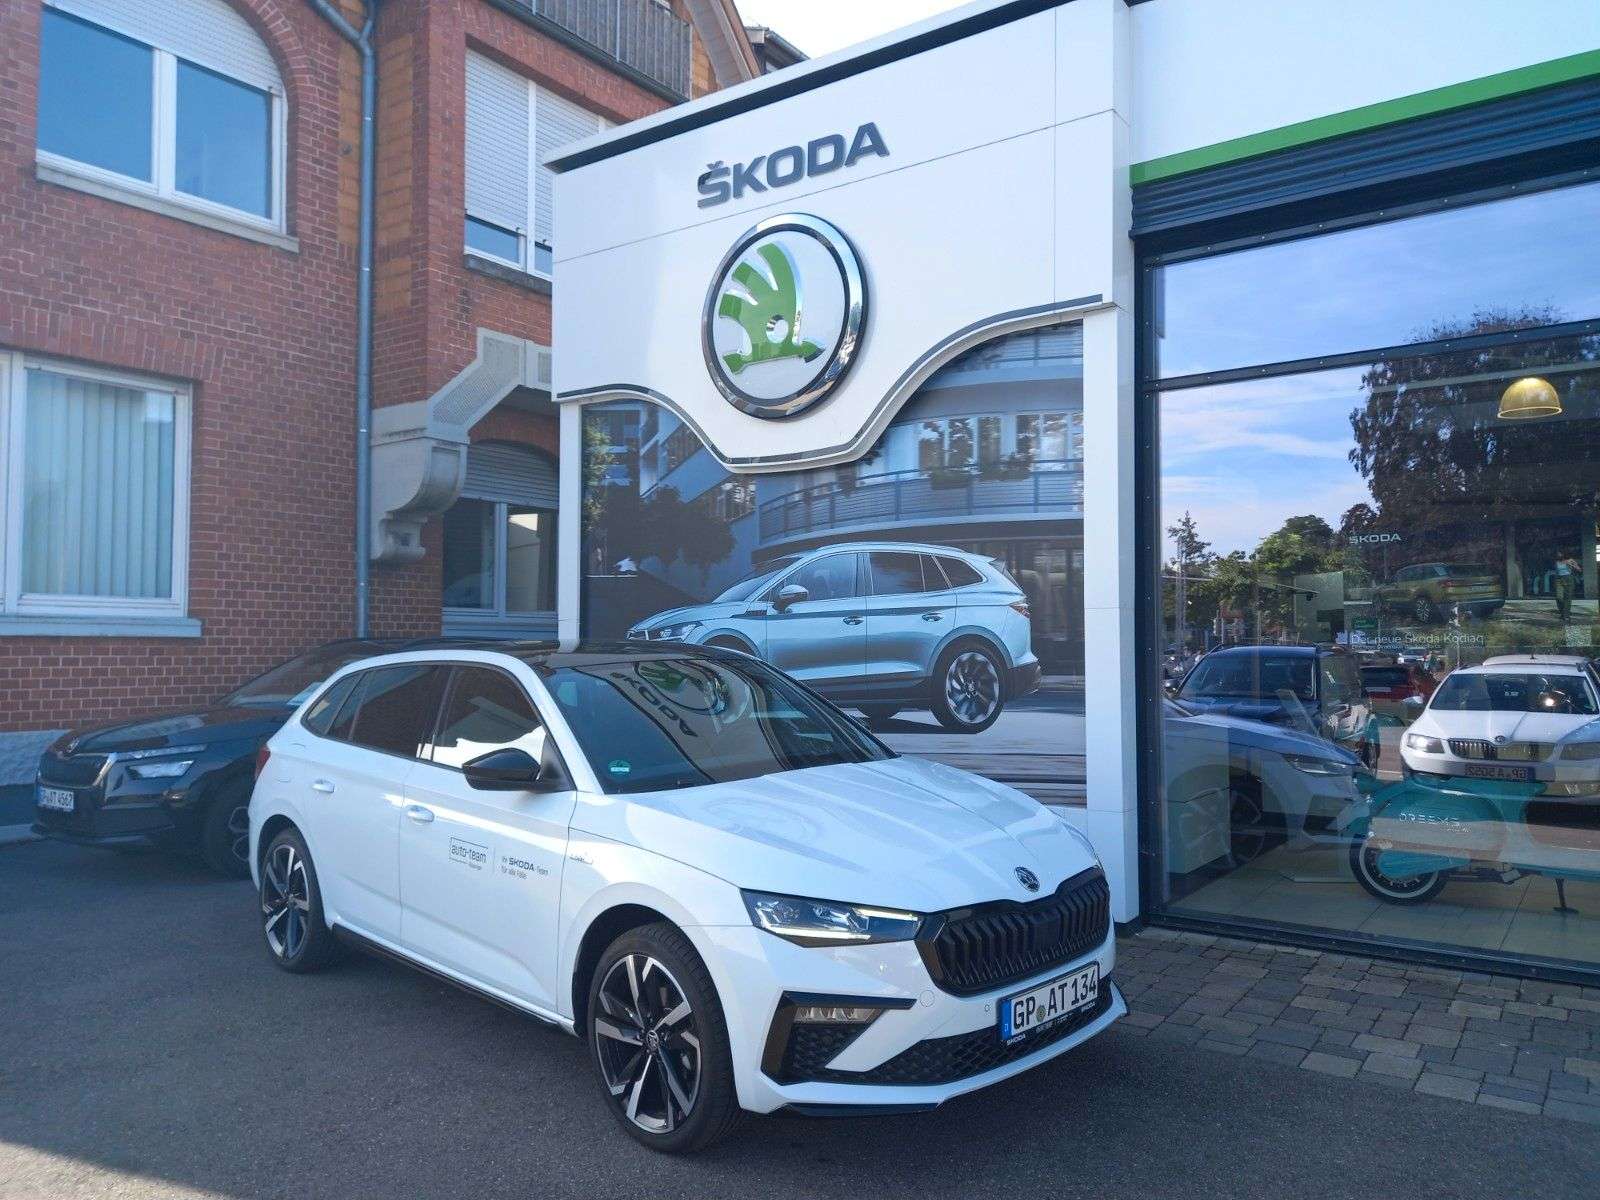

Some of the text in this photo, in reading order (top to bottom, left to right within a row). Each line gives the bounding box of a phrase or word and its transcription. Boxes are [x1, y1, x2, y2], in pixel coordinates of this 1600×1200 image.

[697, 122, 889, 208] ŠKODA
[1375, 635, 1402, 644] neue
[1444, 633, 1484, 645] Kodiaq
[450, 845, 487, 864] auto-team
[1013, 995, 1036, 1030] GP
[1047, 982, 1068, 1018] AT
[1071, 970, 1097, 1006] 134
